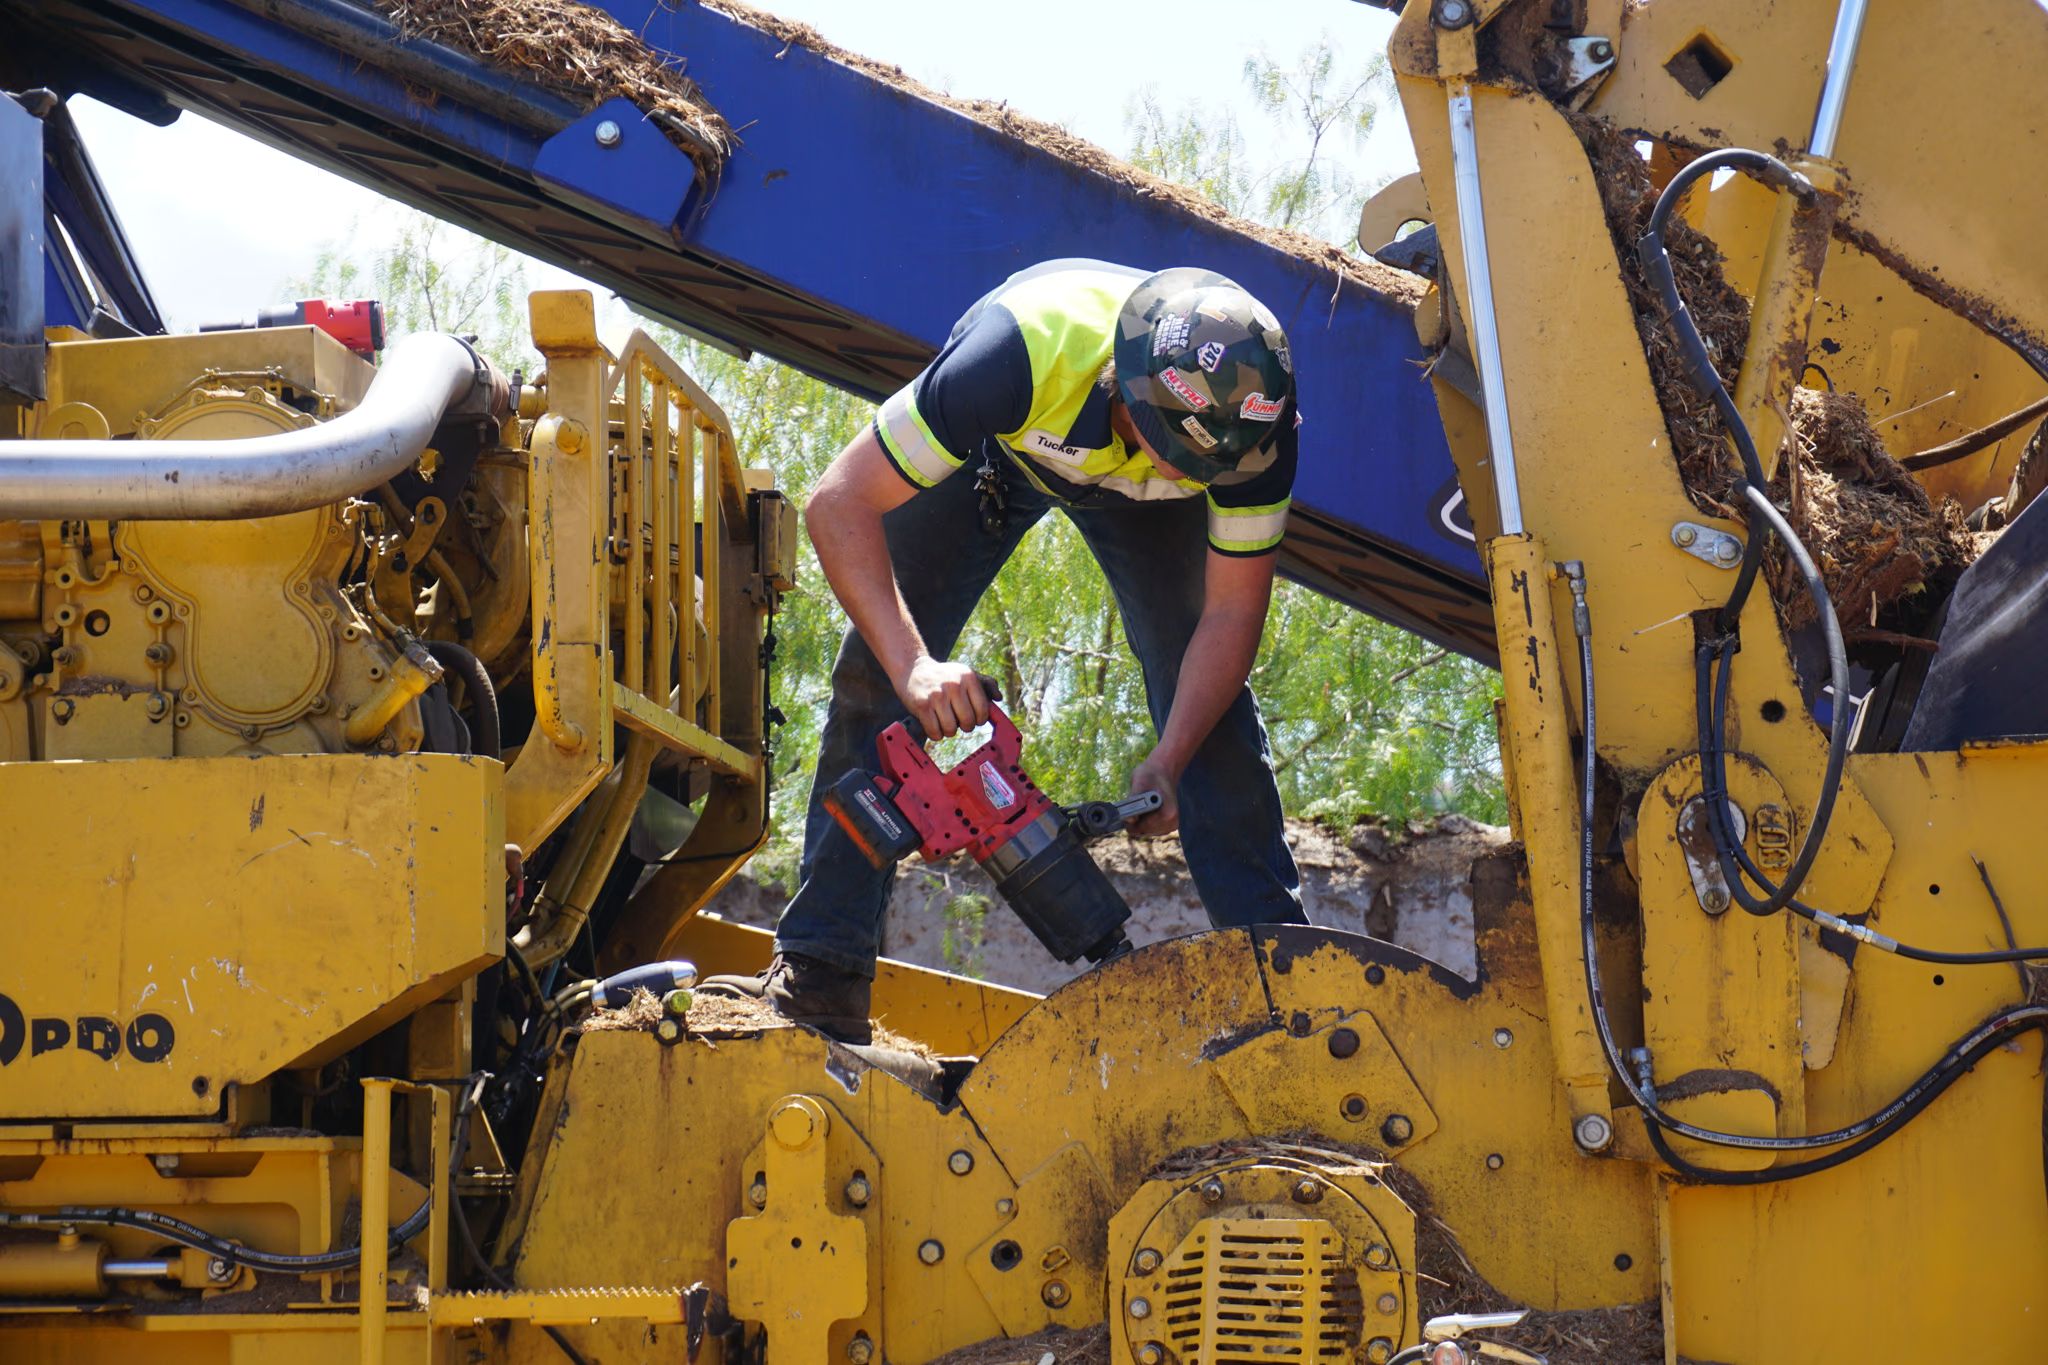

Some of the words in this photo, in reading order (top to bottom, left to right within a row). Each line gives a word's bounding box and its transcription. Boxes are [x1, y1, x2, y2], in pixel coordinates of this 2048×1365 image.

[1202, 342, 1221, 369] 247
[1164, 369, 1209, 408] NITRO
[1037, 435, 1080, 457] Tucker
[1585, 831, 1593, 868] DIEHARD
[1585, 892, 1593, 915] T3000
